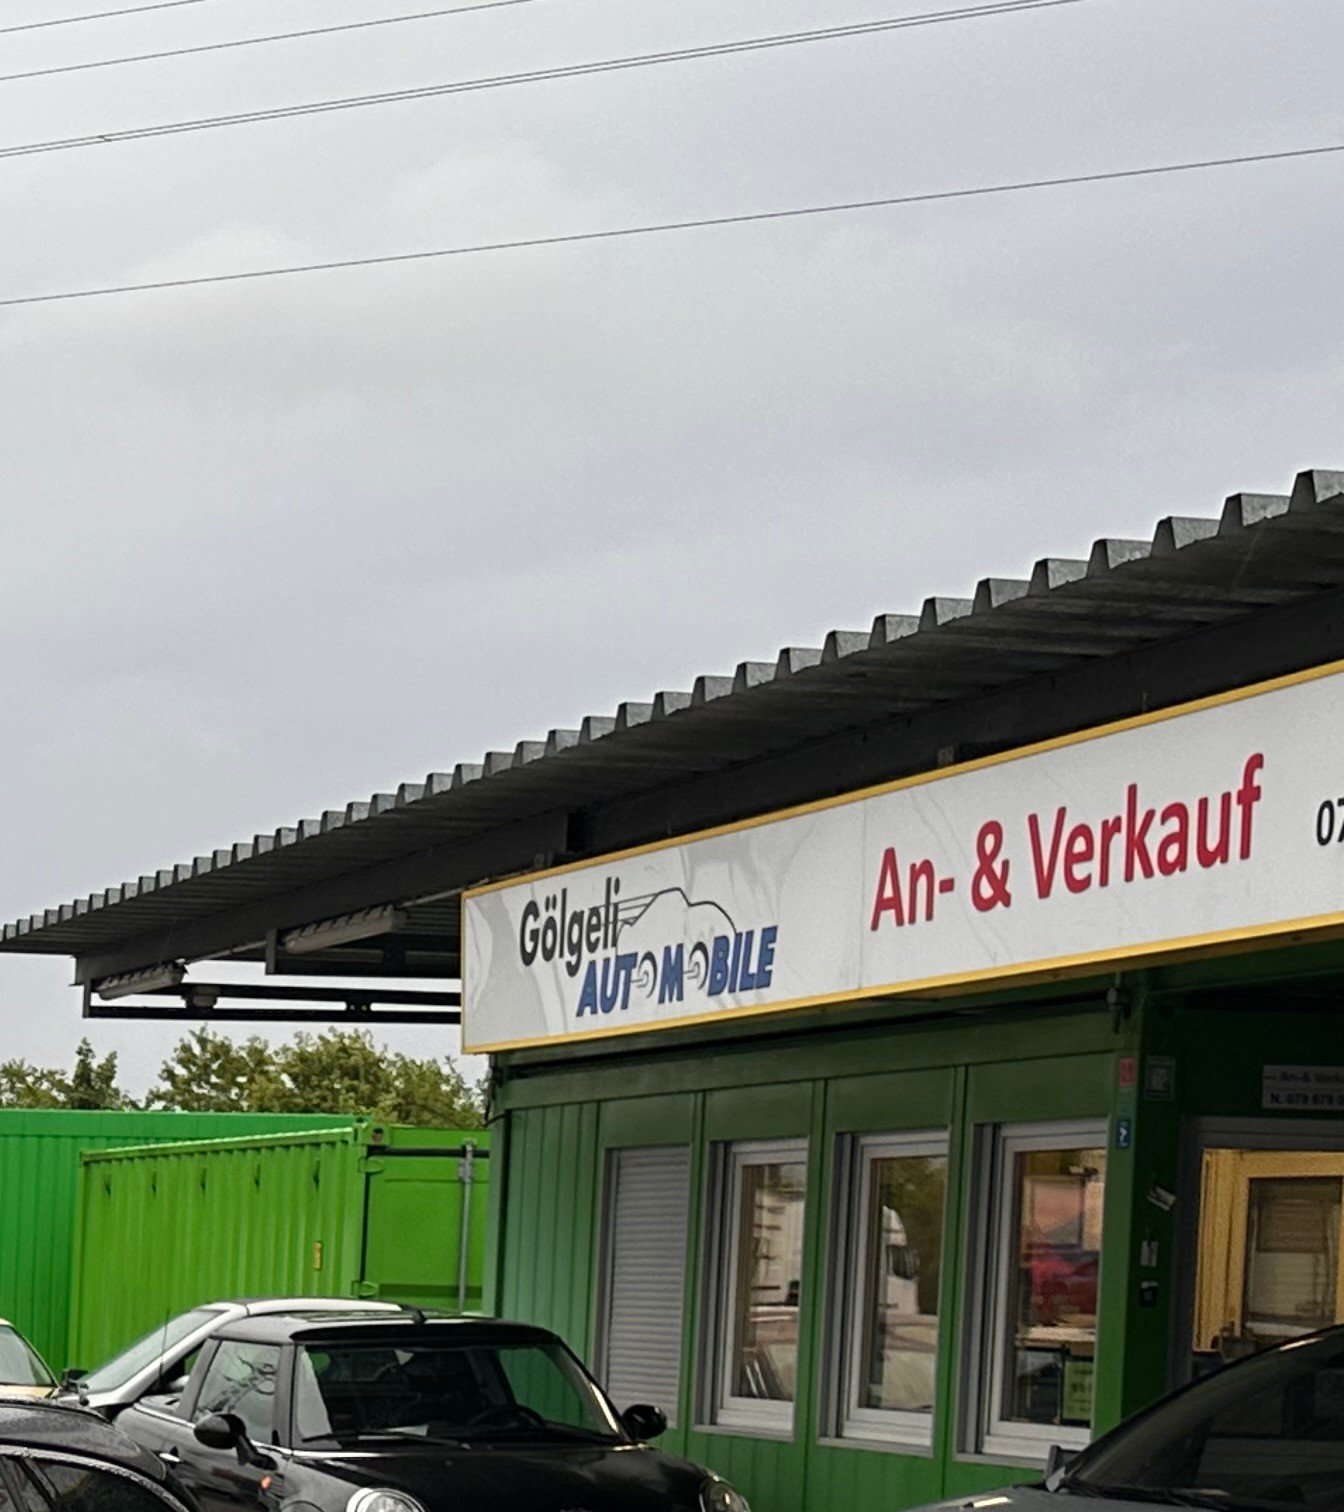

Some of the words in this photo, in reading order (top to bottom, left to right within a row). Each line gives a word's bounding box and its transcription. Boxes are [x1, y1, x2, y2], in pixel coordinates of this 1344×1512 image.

[869, 846, 955, 931] An-
[970, 819, 1012, 913] &
[1027, 752, 1264, 900] Verkauf
[519, 876, 621, 977] Gölgeli
